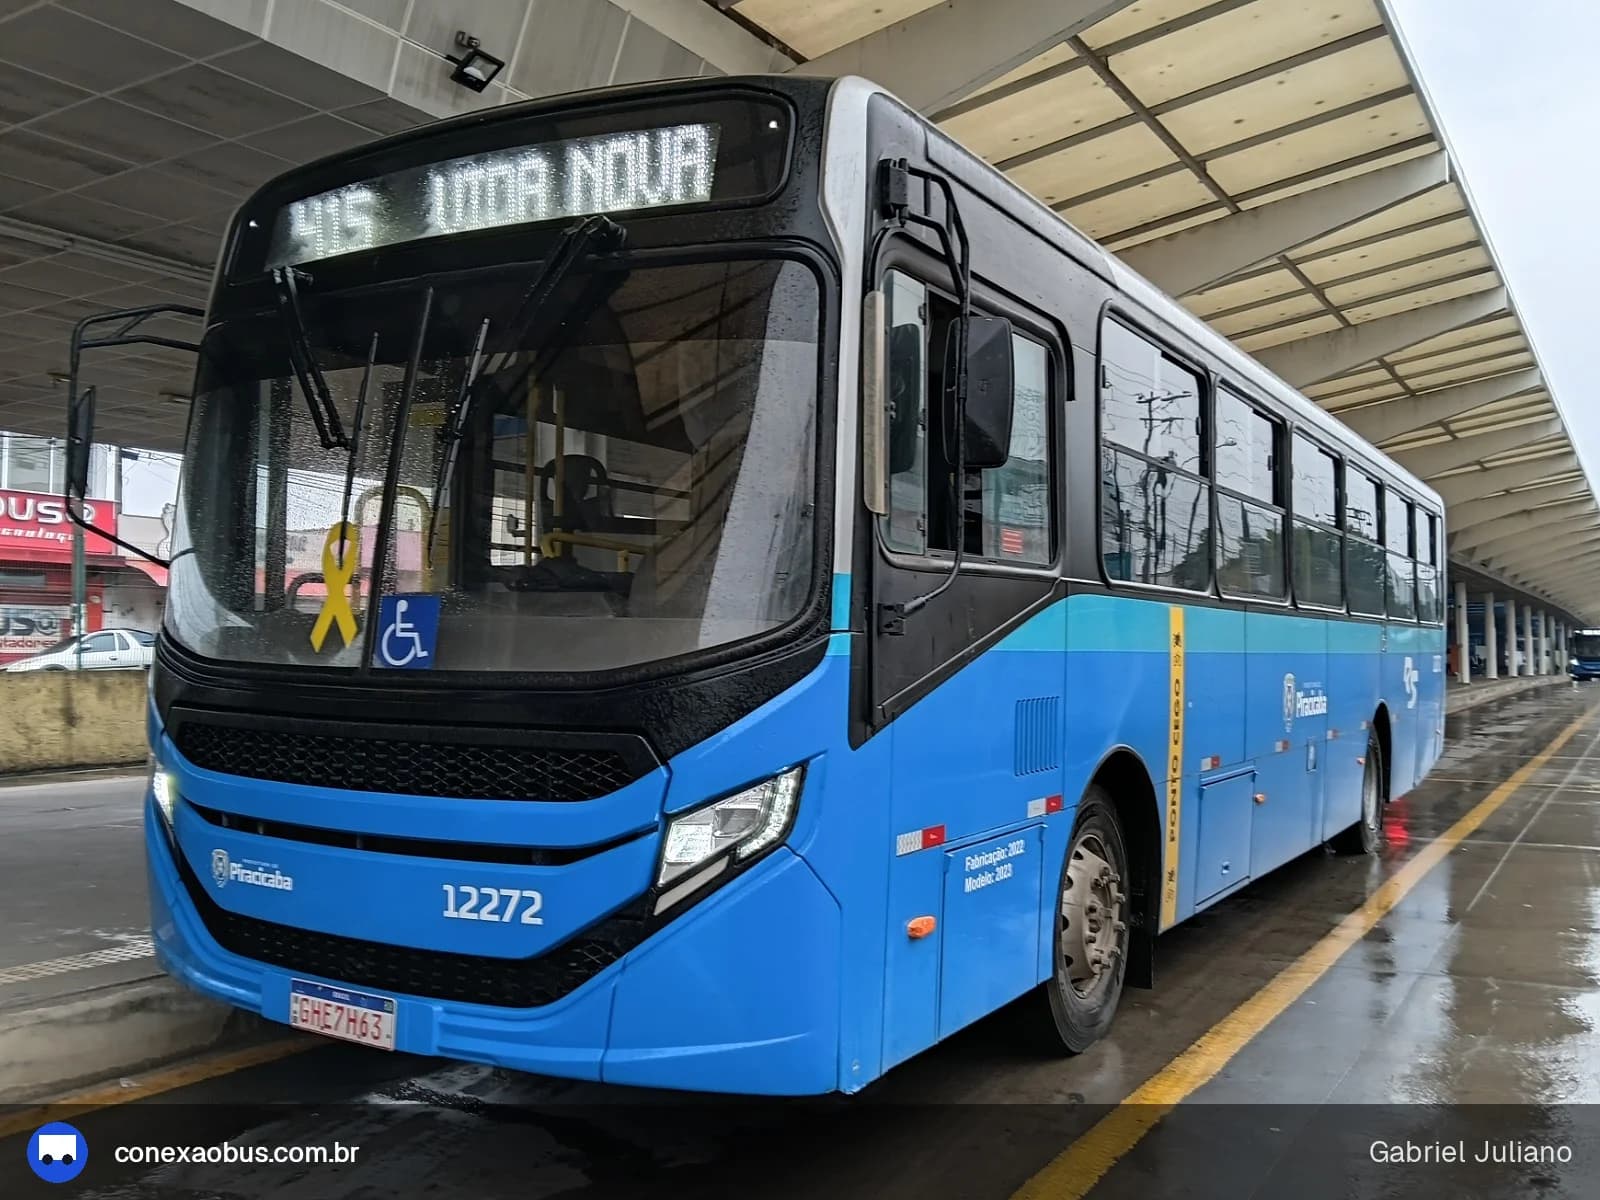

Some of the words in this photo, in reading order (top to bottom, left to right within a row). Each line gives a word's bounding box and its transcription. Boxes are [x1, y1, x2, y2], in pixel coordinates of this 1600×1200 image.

[570, 124, 709, 215] NOVA
[965, 847, 1008, 872] Fabricação:
[1008, 839, 1025, 857] 2022
[230, 862, 293, 891] Piracicaba
[965, 871, 994, 893] Modelo:
[995, 862, 1012, 881] 2023
[443, 884, 543, 925] 12272
[300, 997, 382, 1040] GHE7H63
